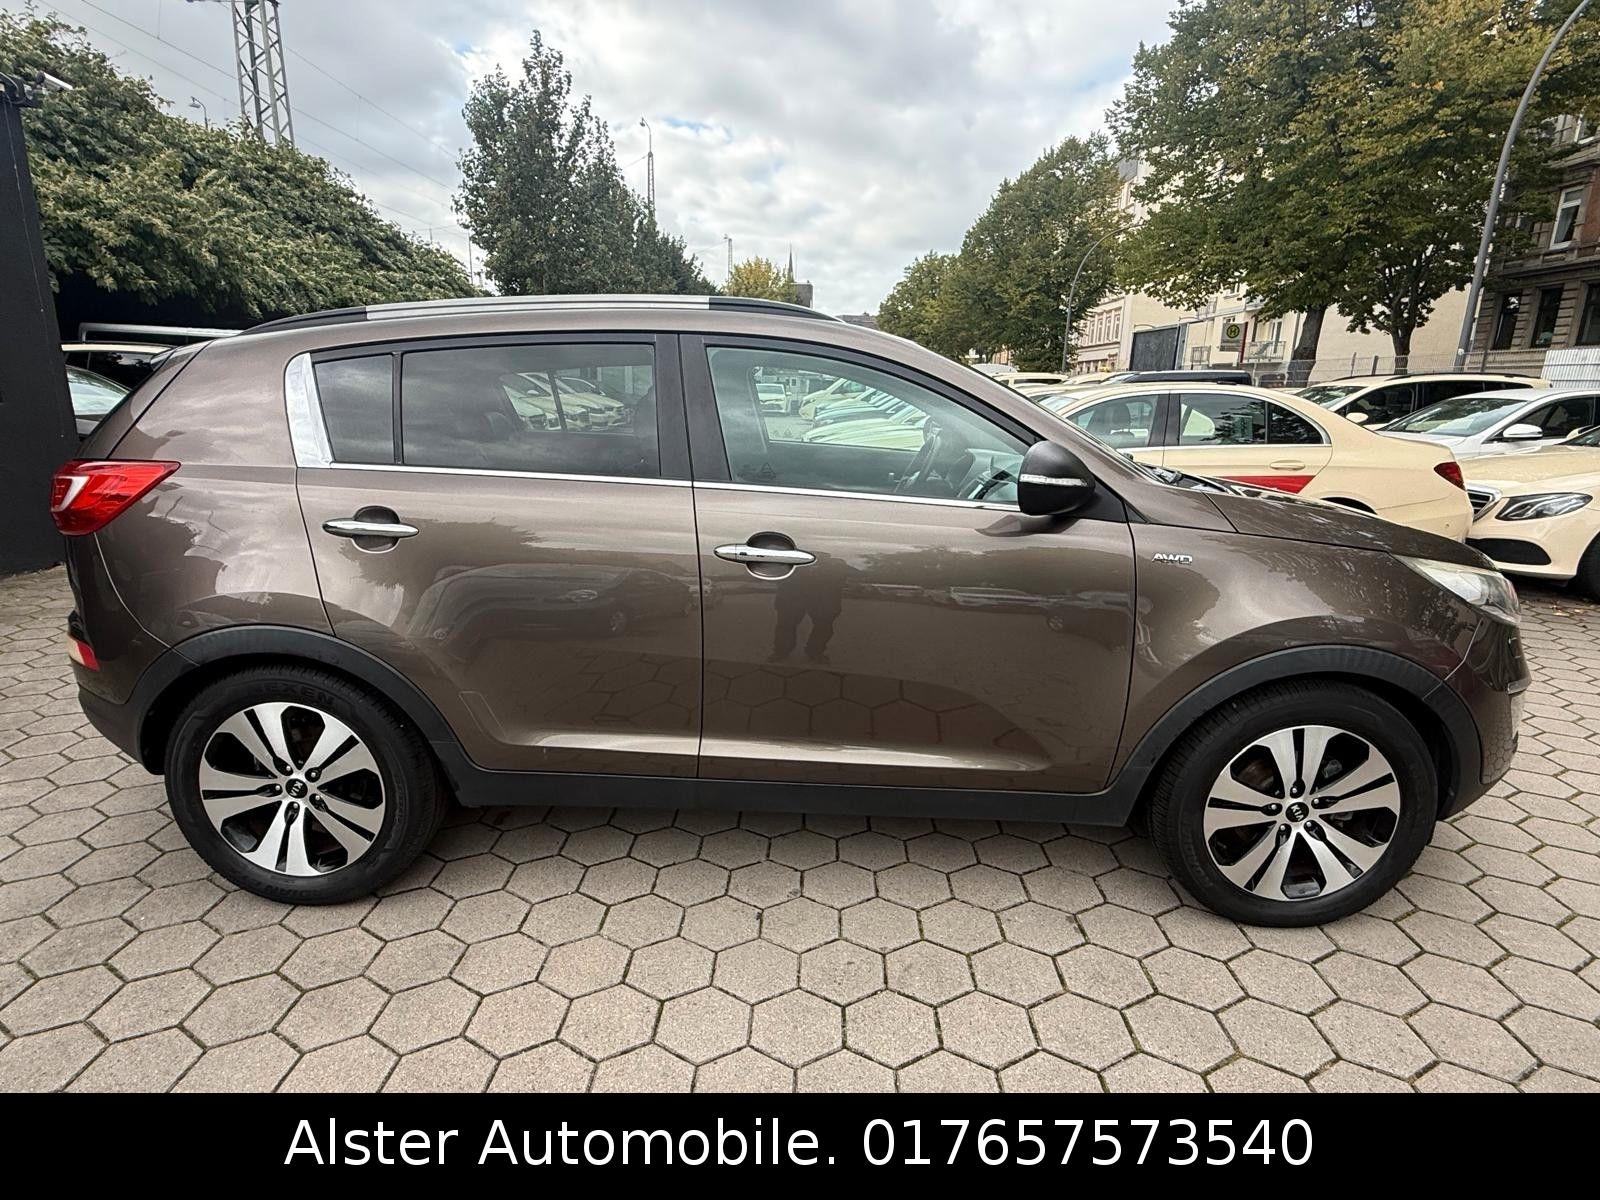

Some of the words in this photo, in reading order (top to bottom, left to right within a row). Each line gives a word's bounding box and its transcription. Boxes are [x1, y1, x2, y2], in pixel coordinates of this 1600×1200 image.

[1151, 552, 1193, 564] AWD
[289, 780, 304, 797] KIA
[1290, 804, 1304, 821] KIA
